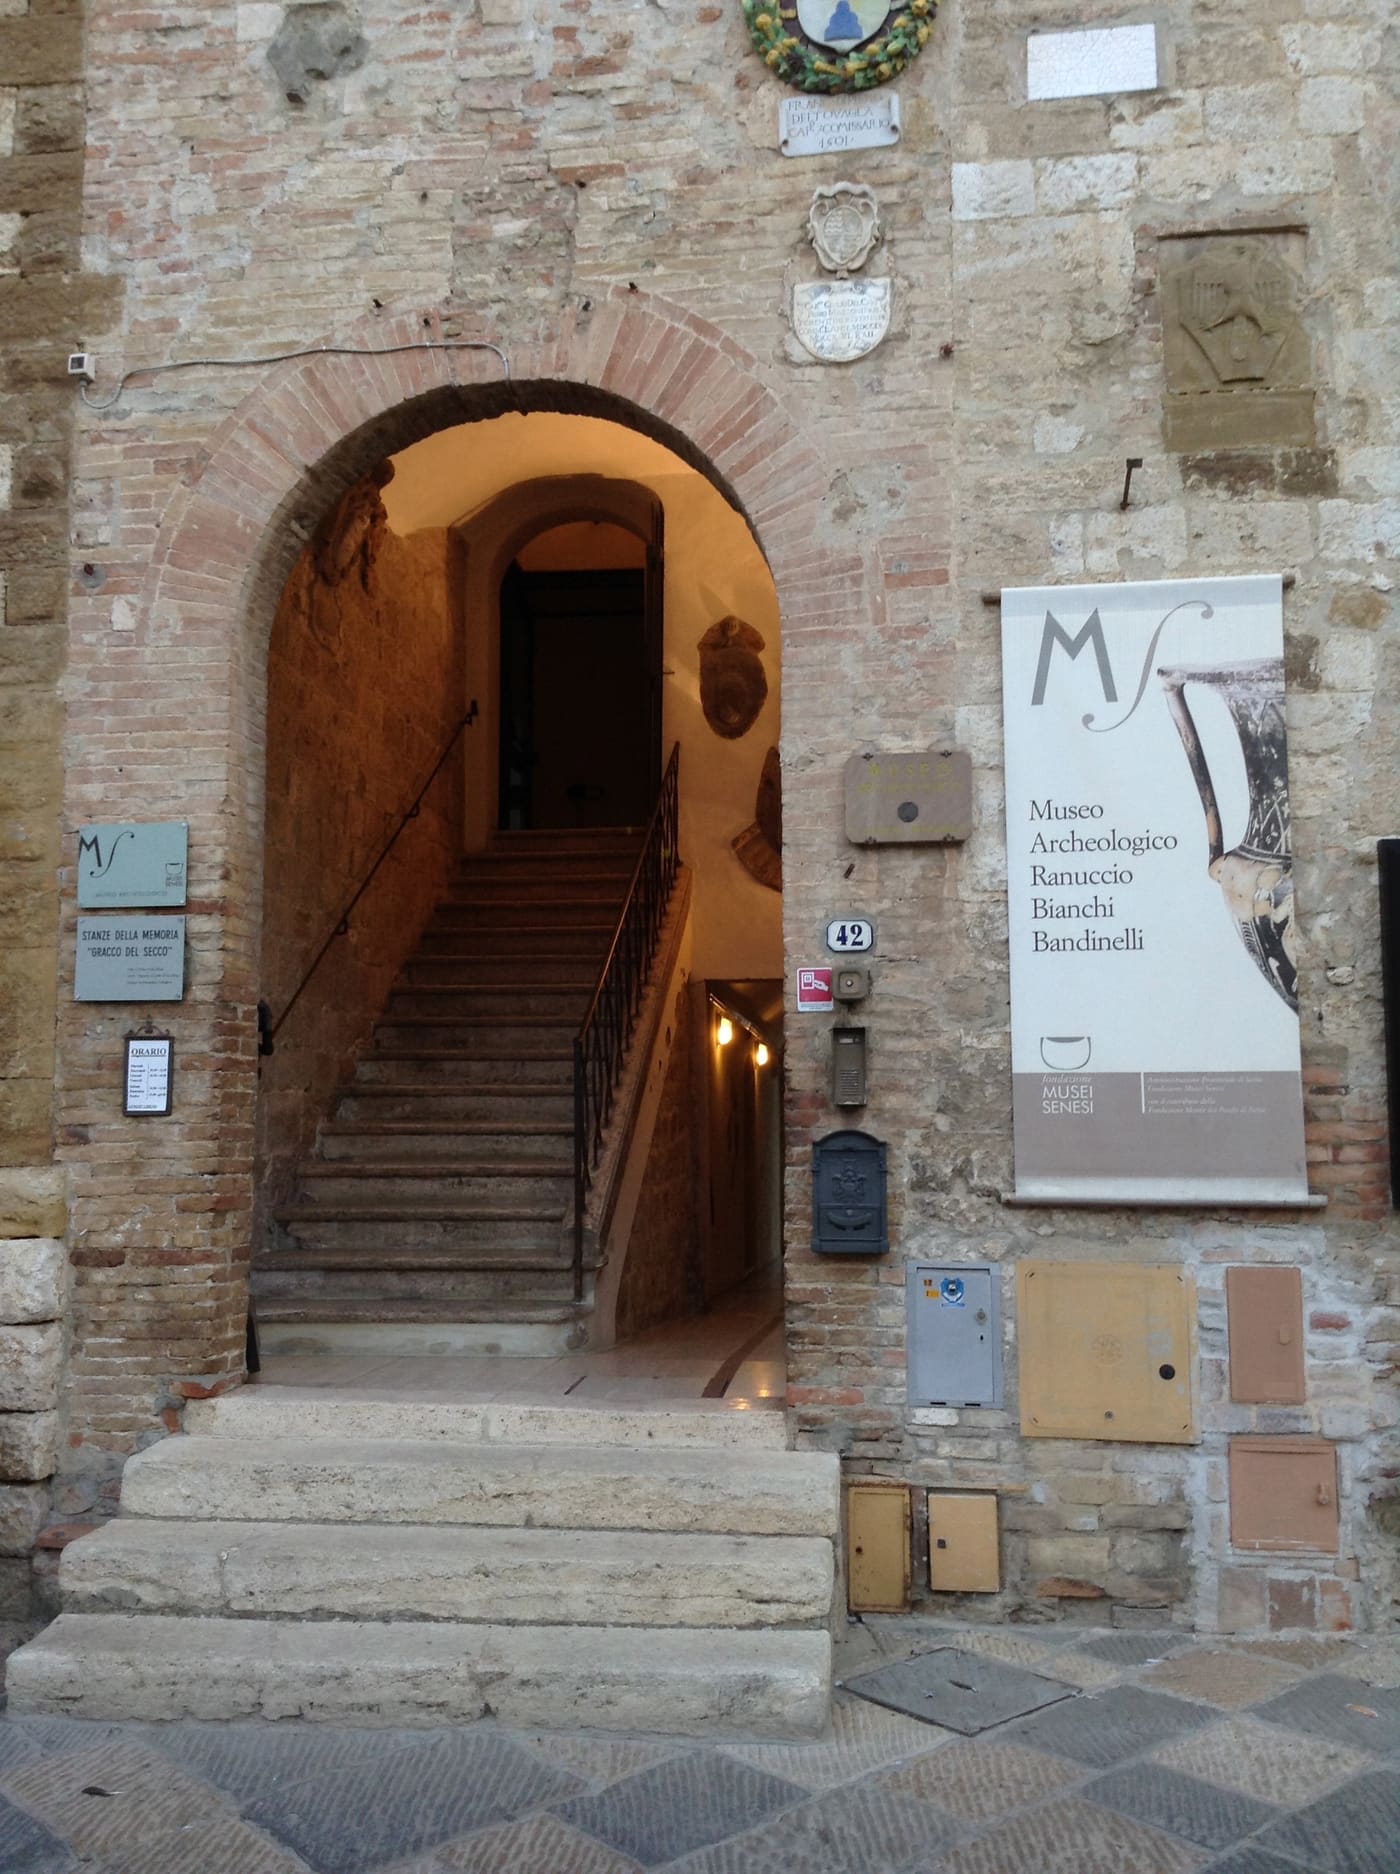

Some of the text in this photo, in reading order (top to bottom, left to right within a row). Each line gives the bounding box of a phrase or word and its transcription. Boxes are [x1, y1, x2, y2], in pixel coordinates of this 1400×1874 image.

[1029, 799, 1104, 821] Museo
[1029, 829, 1178, 856] Archeologico
[1030, 863, 1134, 886] Ranuccio
[1031, 895, 1115, 919] Bianchi
[82, 929, 179, 940] STANZE DELLA MEMORIA
[836, 924, 864, 946] 42
[1032, 927, 1145, 952] Bandinelli
[125, 947, 139, 957] DEL
[131, 1047, 167, 1056] ORARIO
[1042, 1085, 1093, 1099] MUSEI
[1042, 1100, 1093, 1114] SENESI
